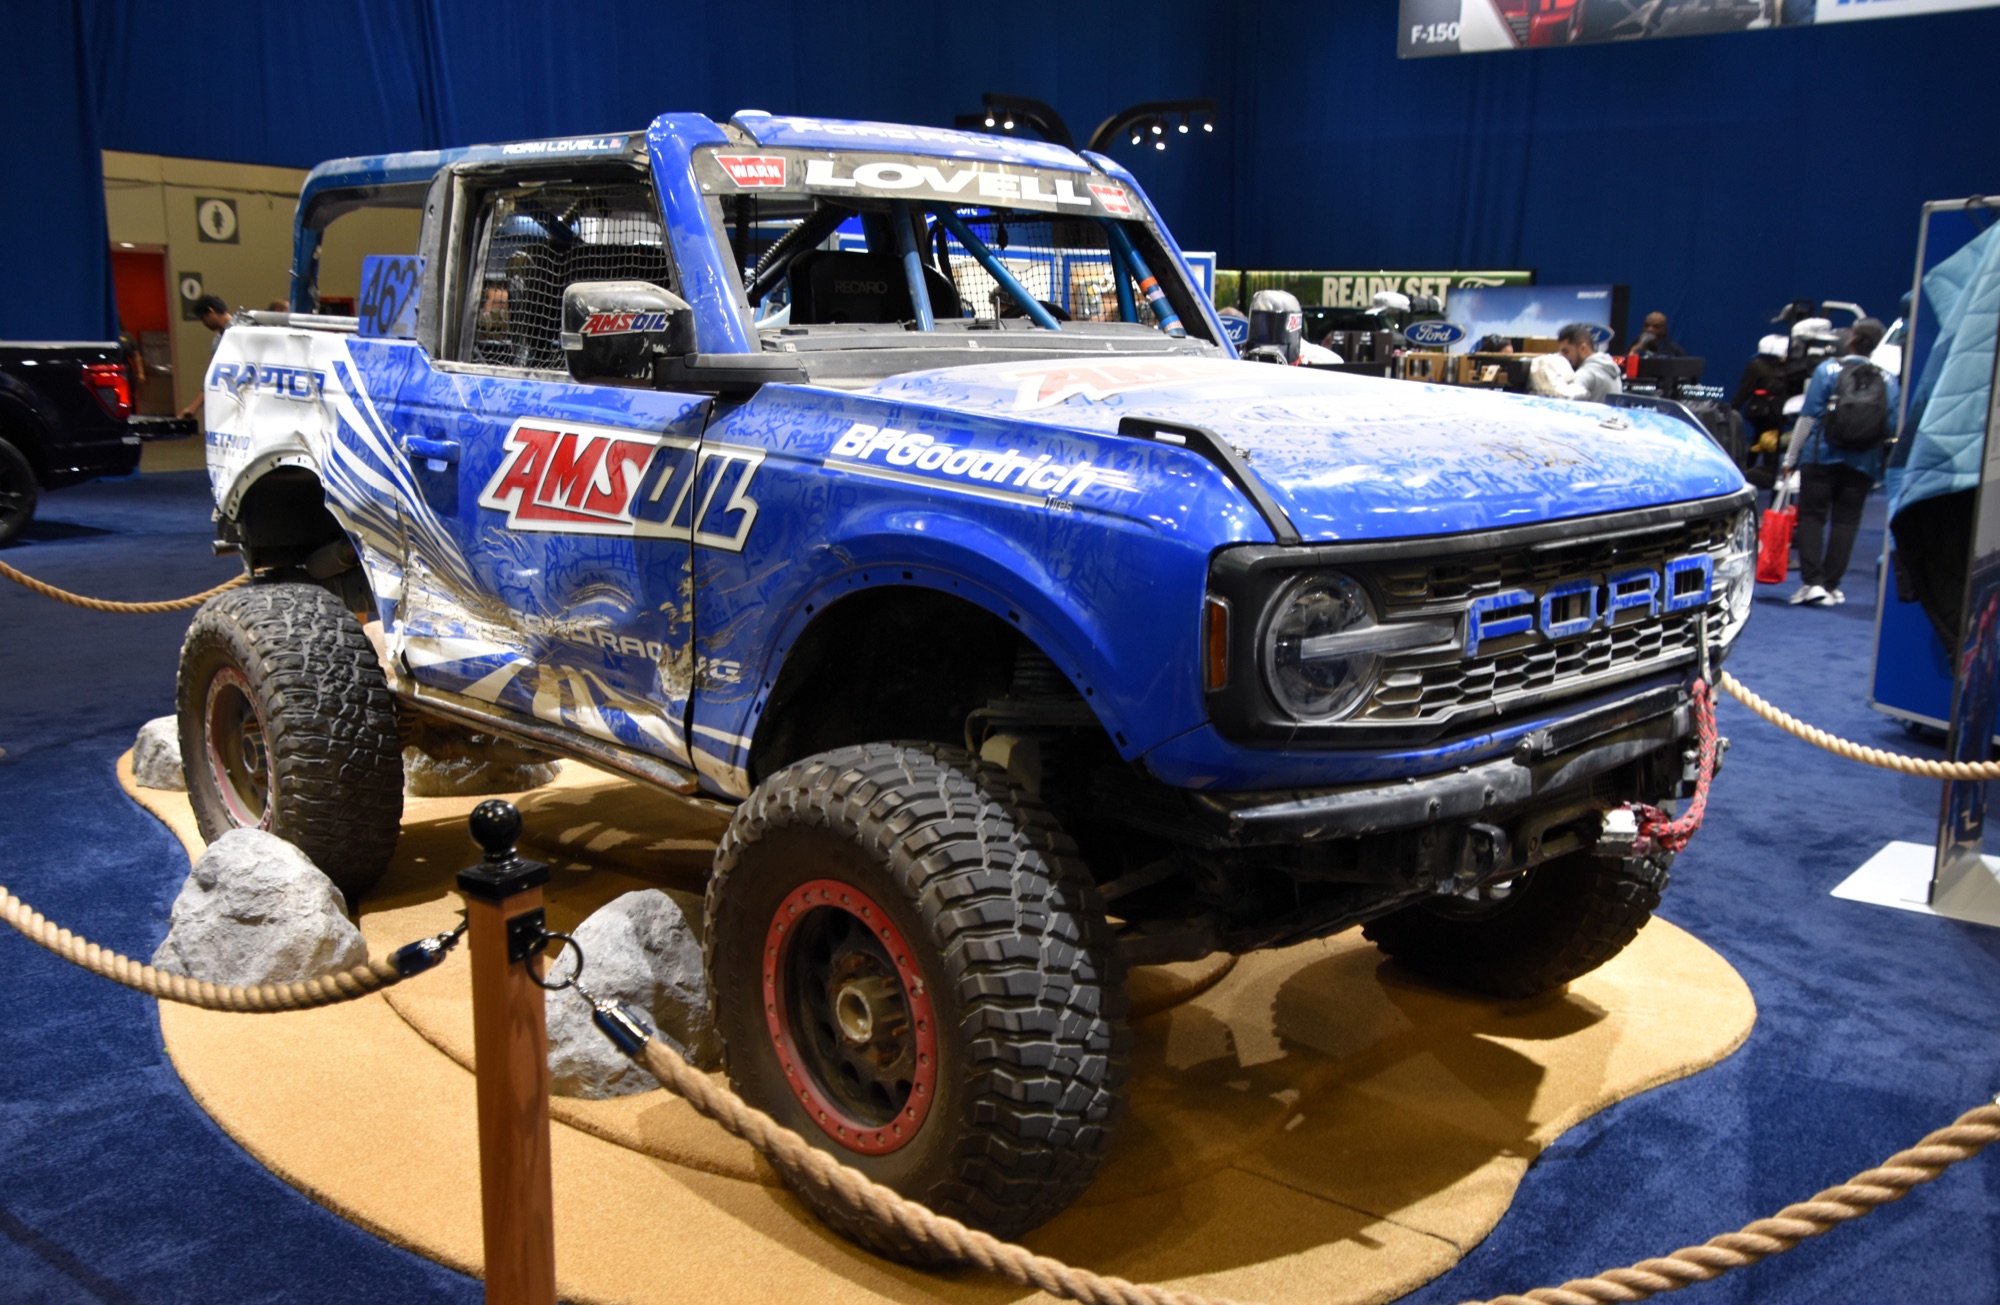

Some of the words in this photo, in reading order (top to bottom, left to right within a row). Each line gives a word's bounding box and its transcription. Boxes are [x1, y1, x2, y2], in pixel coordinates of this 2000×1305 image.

[1411, 22, 1460, 45] F-150
[546, 139, 609, 152] LOVELL
[730, 164, 782, 178] WARN
[805, 159, 1092, 206] LOVELL
[360, 258, 419, 336] 462
[834, 279, 888, 295] RECARO
[1322, 276, 1403, 308] READY
[1404, 276, 1452, 308] SET
[581, 312, 668, 336] AMSOIL
[1415, 323, 1452, 342] Ford
[209, 362, 326, 405] RAPTOR
[830, 422, 1098, 497] BFGoodrich
[488, 424, 764, 542] AMSOIL
[1045, 494, 1074, 513] Tires
[1464, 552, 1714, 660] FORD
